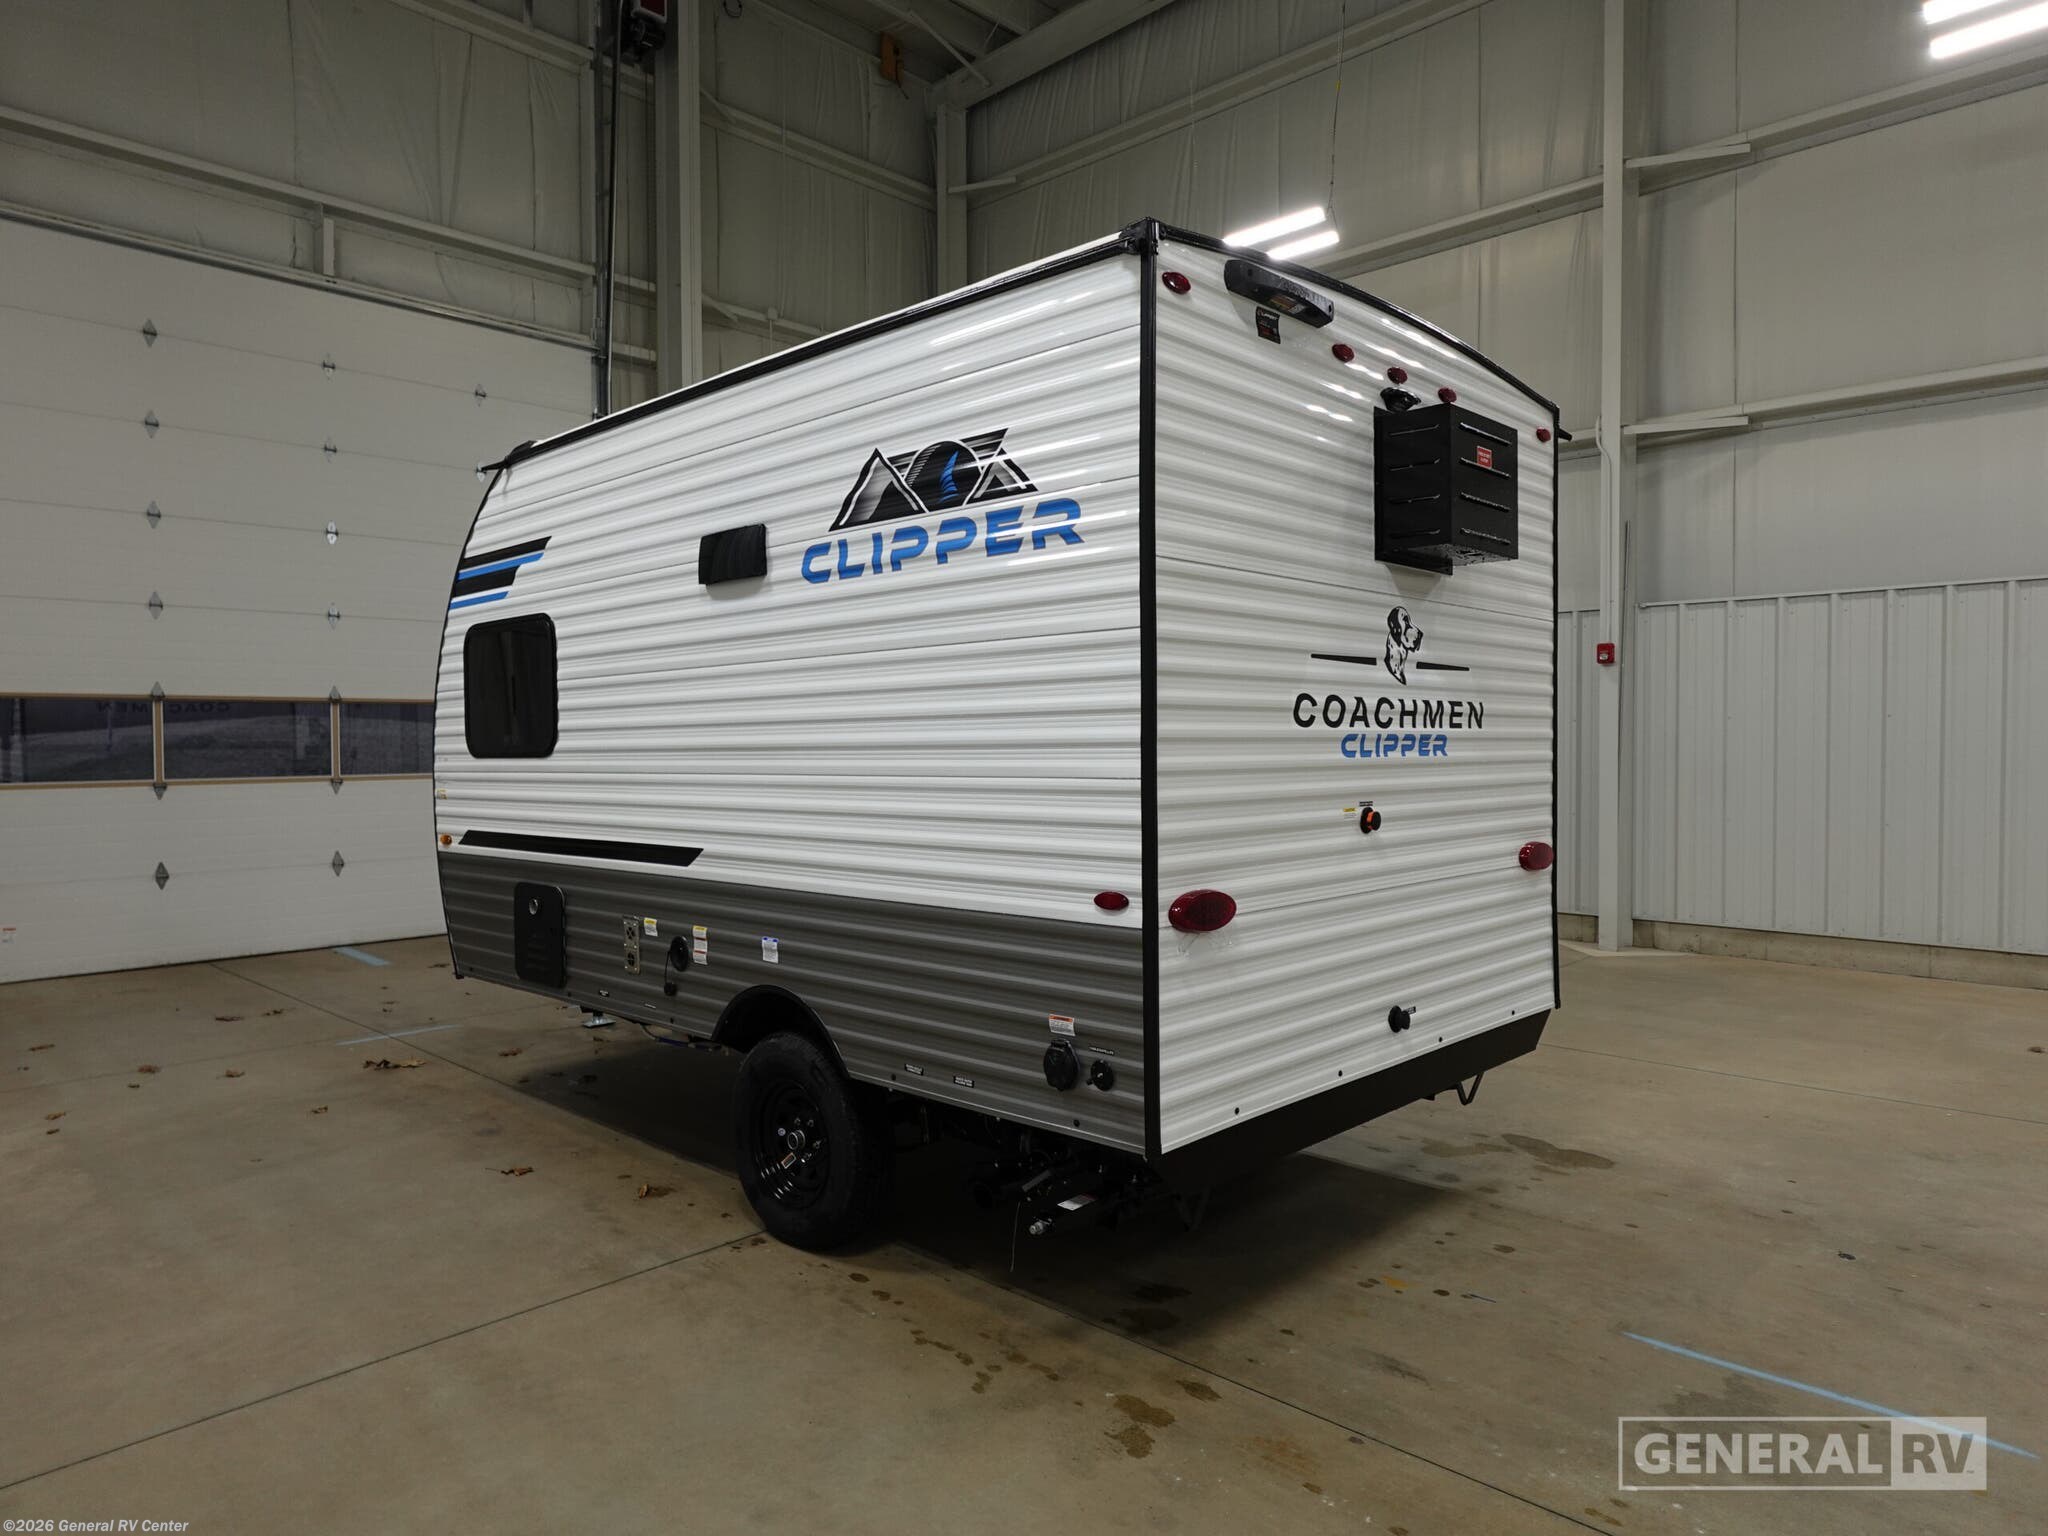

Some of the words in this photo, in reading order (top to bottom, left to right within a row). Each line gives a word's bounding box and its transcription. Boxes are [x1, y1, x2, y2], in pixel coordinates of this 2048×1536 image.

[800, 497, 1085, 584] CLIPPER
[1293, 692, 1485, 730] COACHMEN
[1340, 733, 1449, 758] CLIPPER
